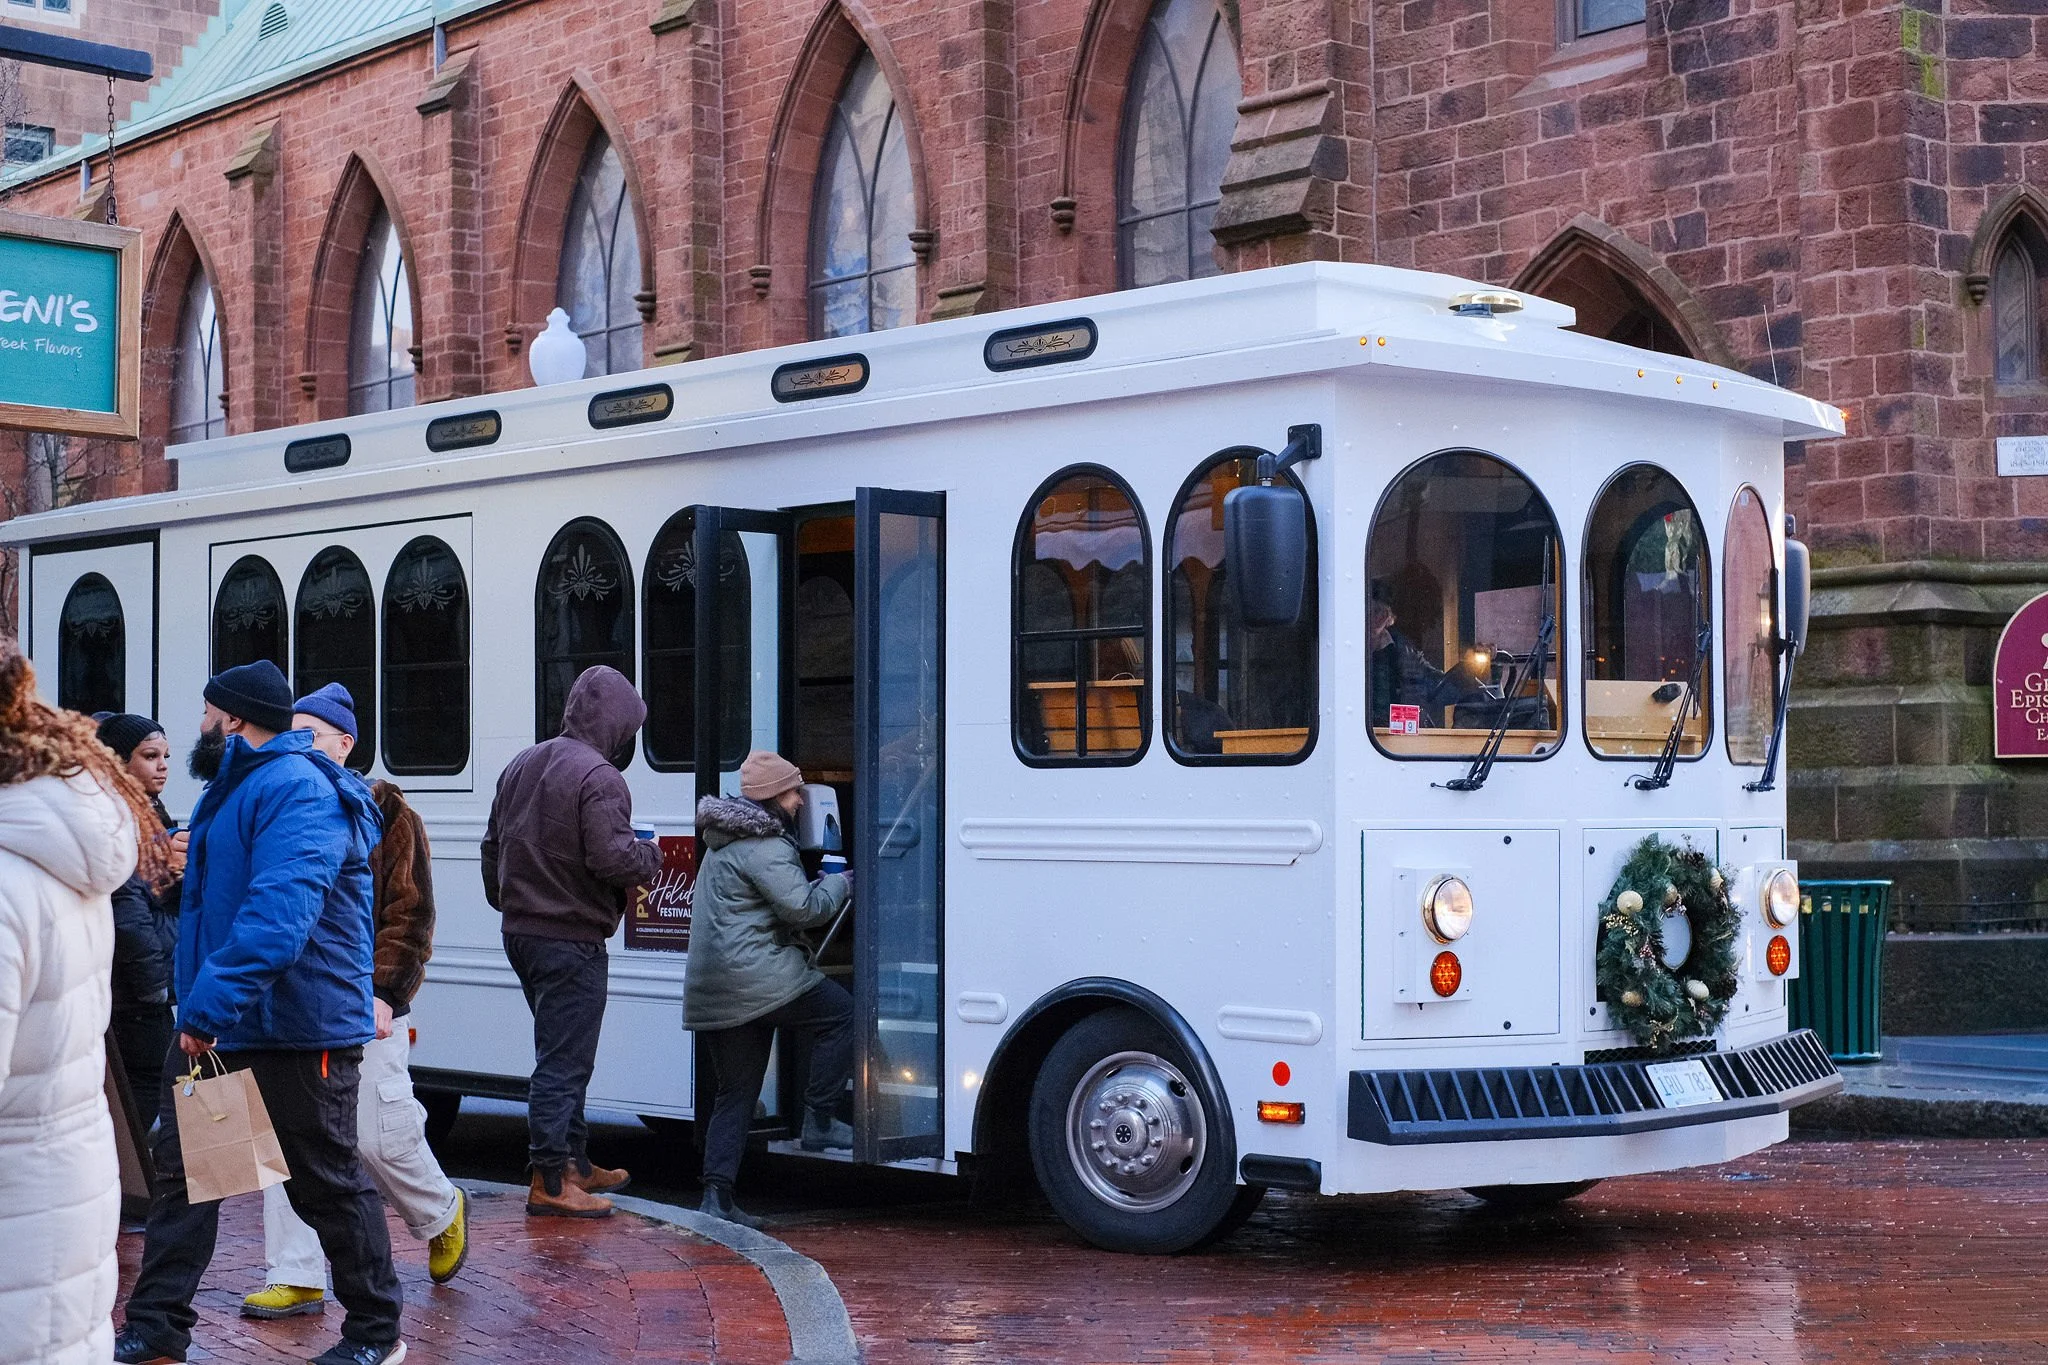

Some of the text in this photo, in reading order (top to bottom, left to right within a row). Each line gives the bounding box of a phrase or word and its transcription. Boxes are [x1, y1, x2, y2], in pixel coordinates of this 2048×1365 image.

[0, 290, 98, 333] ENI'S
[34, 337, 83, 358] Flavors
[1408, 722, 1412, 731] 9
[2025, 708, 2048, 724] CH
[636, 881, 649, 919] PV
[1658, 1072, 1712, 1096] 1RU 783
